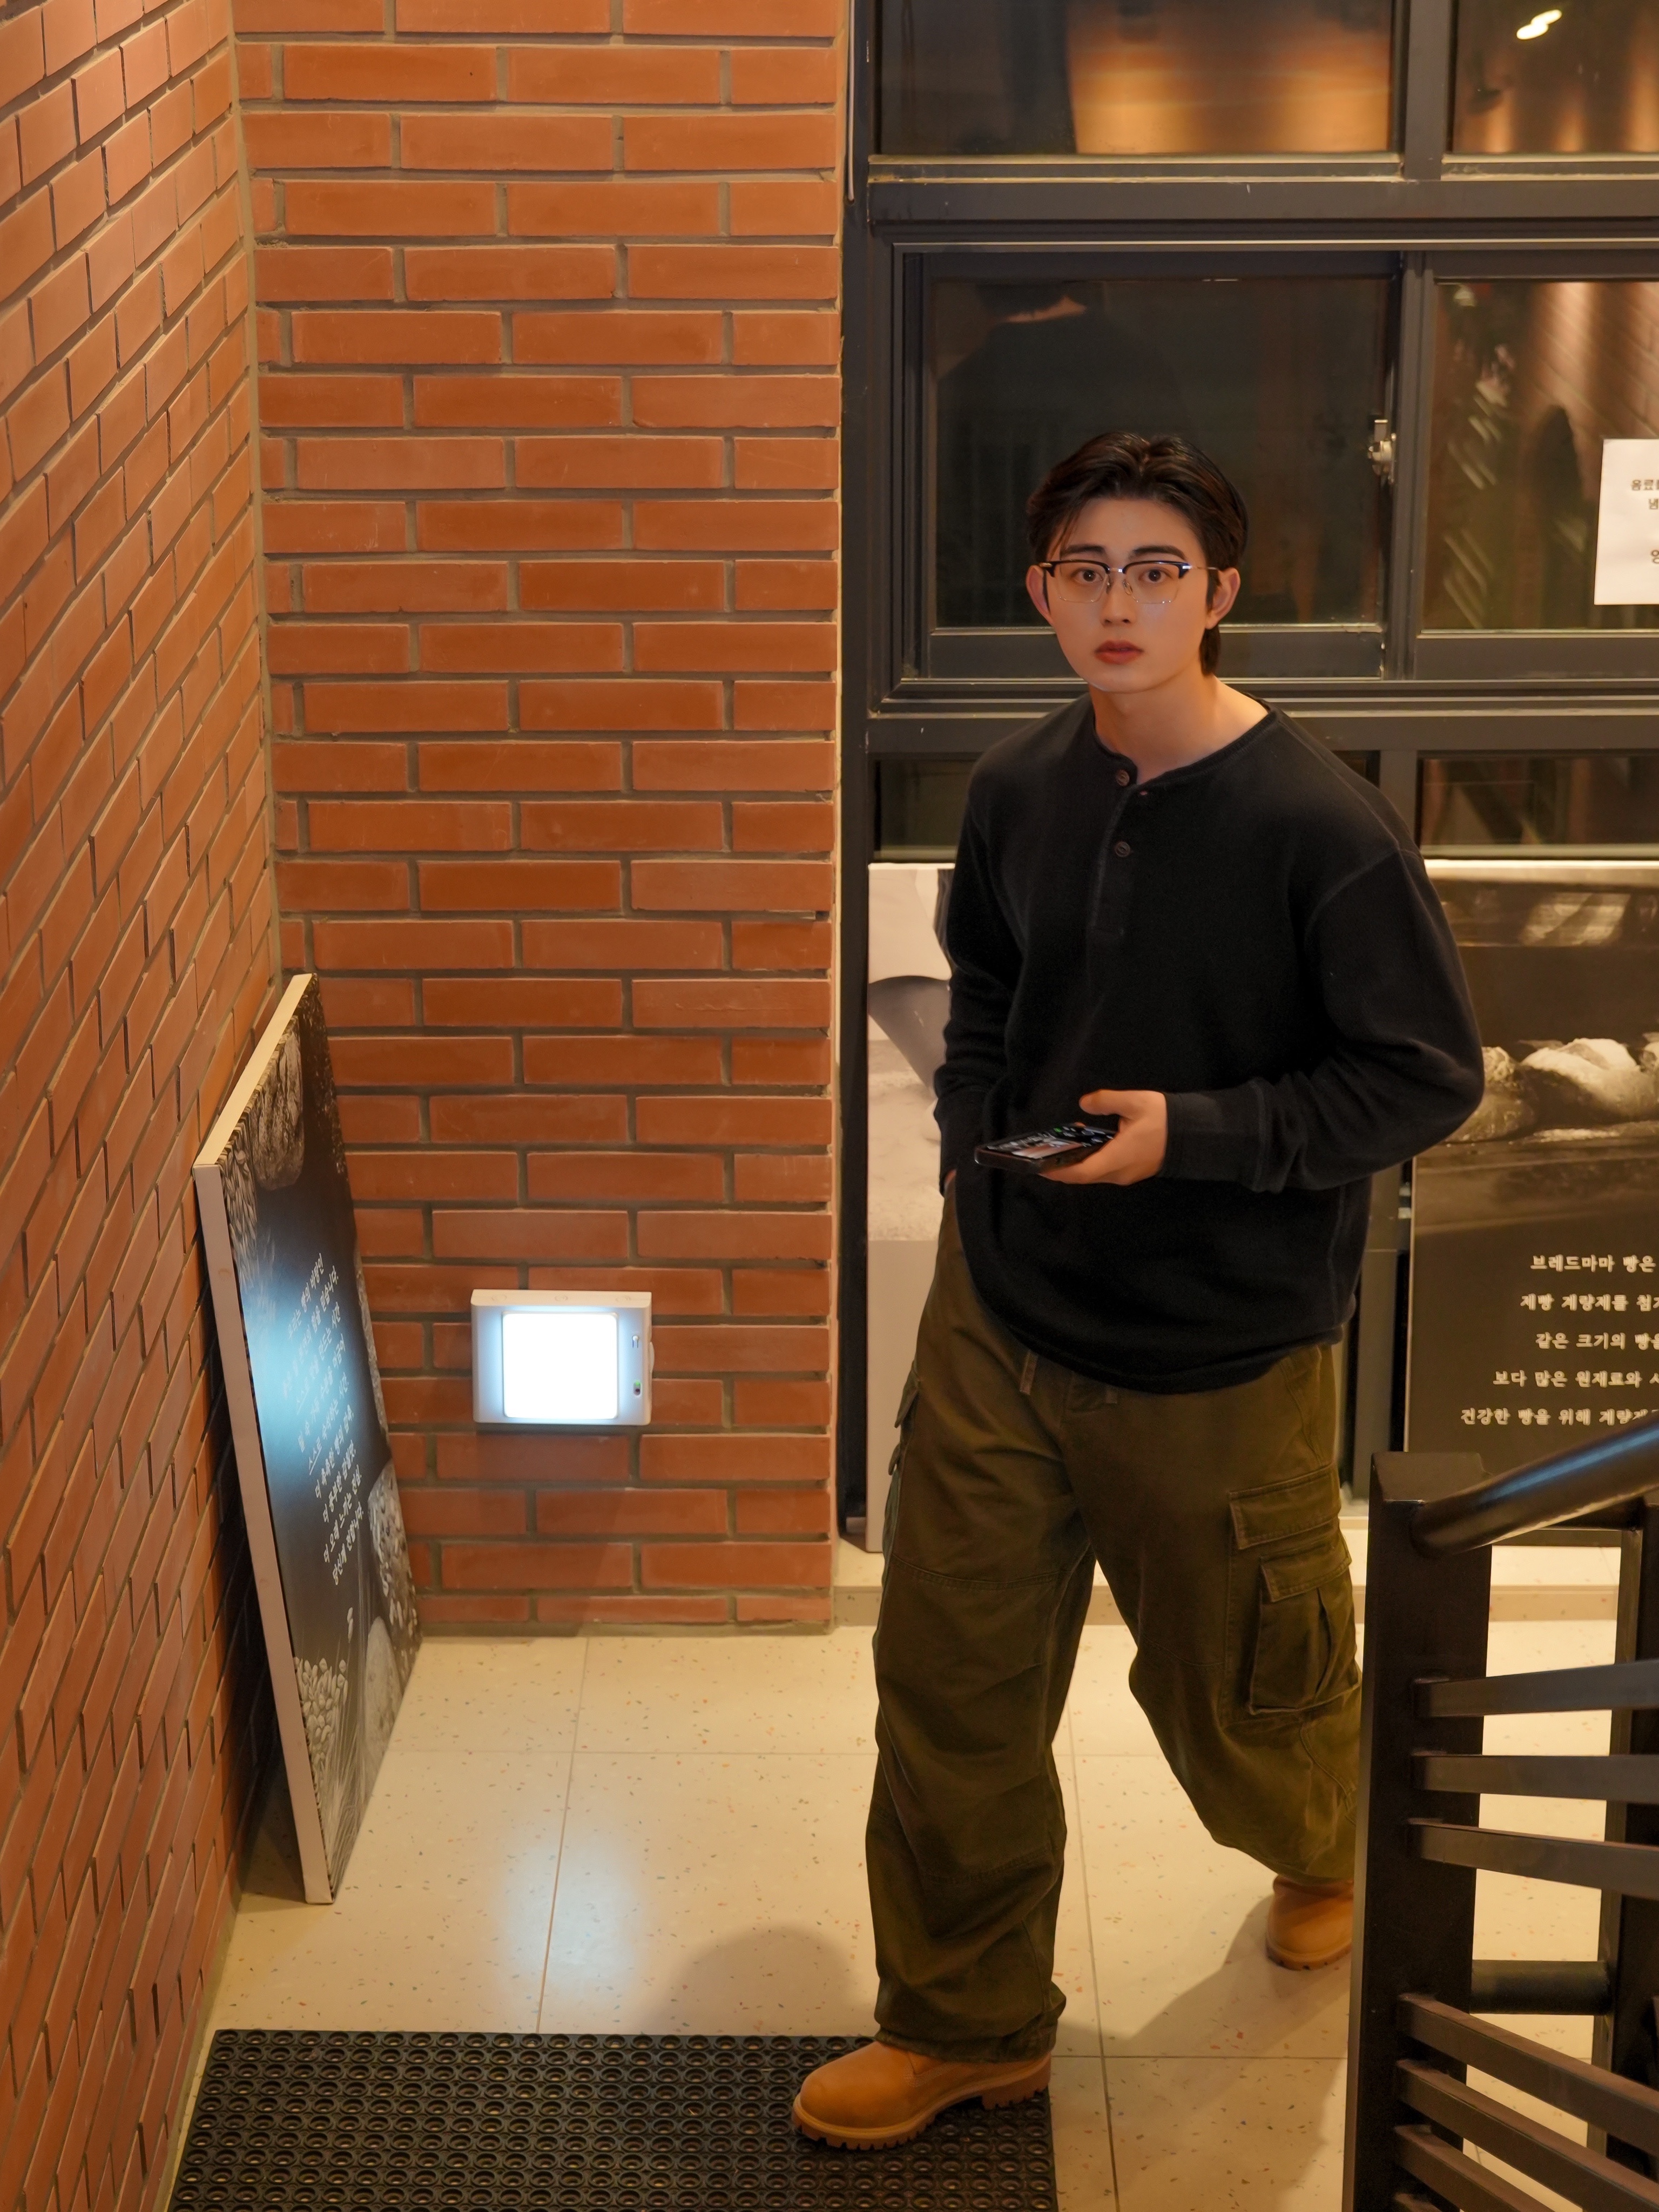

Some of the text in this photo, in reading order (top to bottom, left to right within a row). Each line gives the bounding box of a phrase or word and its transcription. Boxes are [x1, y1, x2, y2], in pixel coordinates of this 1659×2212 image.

[310, 1252, 324, 1289] 바탕인
[1530, 1254, 1656, 1273] 브레드마마 빵은
[320, 1265, 339, 1312] 믿습니다.
[1520, 1293, 1554, 1311] 제빵
[319, 1327, 332, 1361] 만드는
[332, 1301, 341, 1327] 시간
[1535, 1332, 1569, 1349] 같은
[1576, 1332, 1626, 1350] 크기의
[1493, 1370, 1527, 1387] 보다
[1534, 1370, 1568, 1388] 많은
[1575, 1370, 1642, 1388] 원재료와
[308, 1437, 322, 1476] 스스로
[339, 1371, 349, 1397] 시간.
[1461, 1407, 1510, 1426] 건강한
[1518, 1408, 1551, 1426] 빵을
[1558, 1408, 1591, 1426] 위해
[315, 1480, 321, 1498] 더
[322, 1503, 329, 1523] 더
[328, 1471, 342, 1512] 풍부한
[323, 1543, 330, 1563] 더
[330, 1520, 340, 1552] 오래
